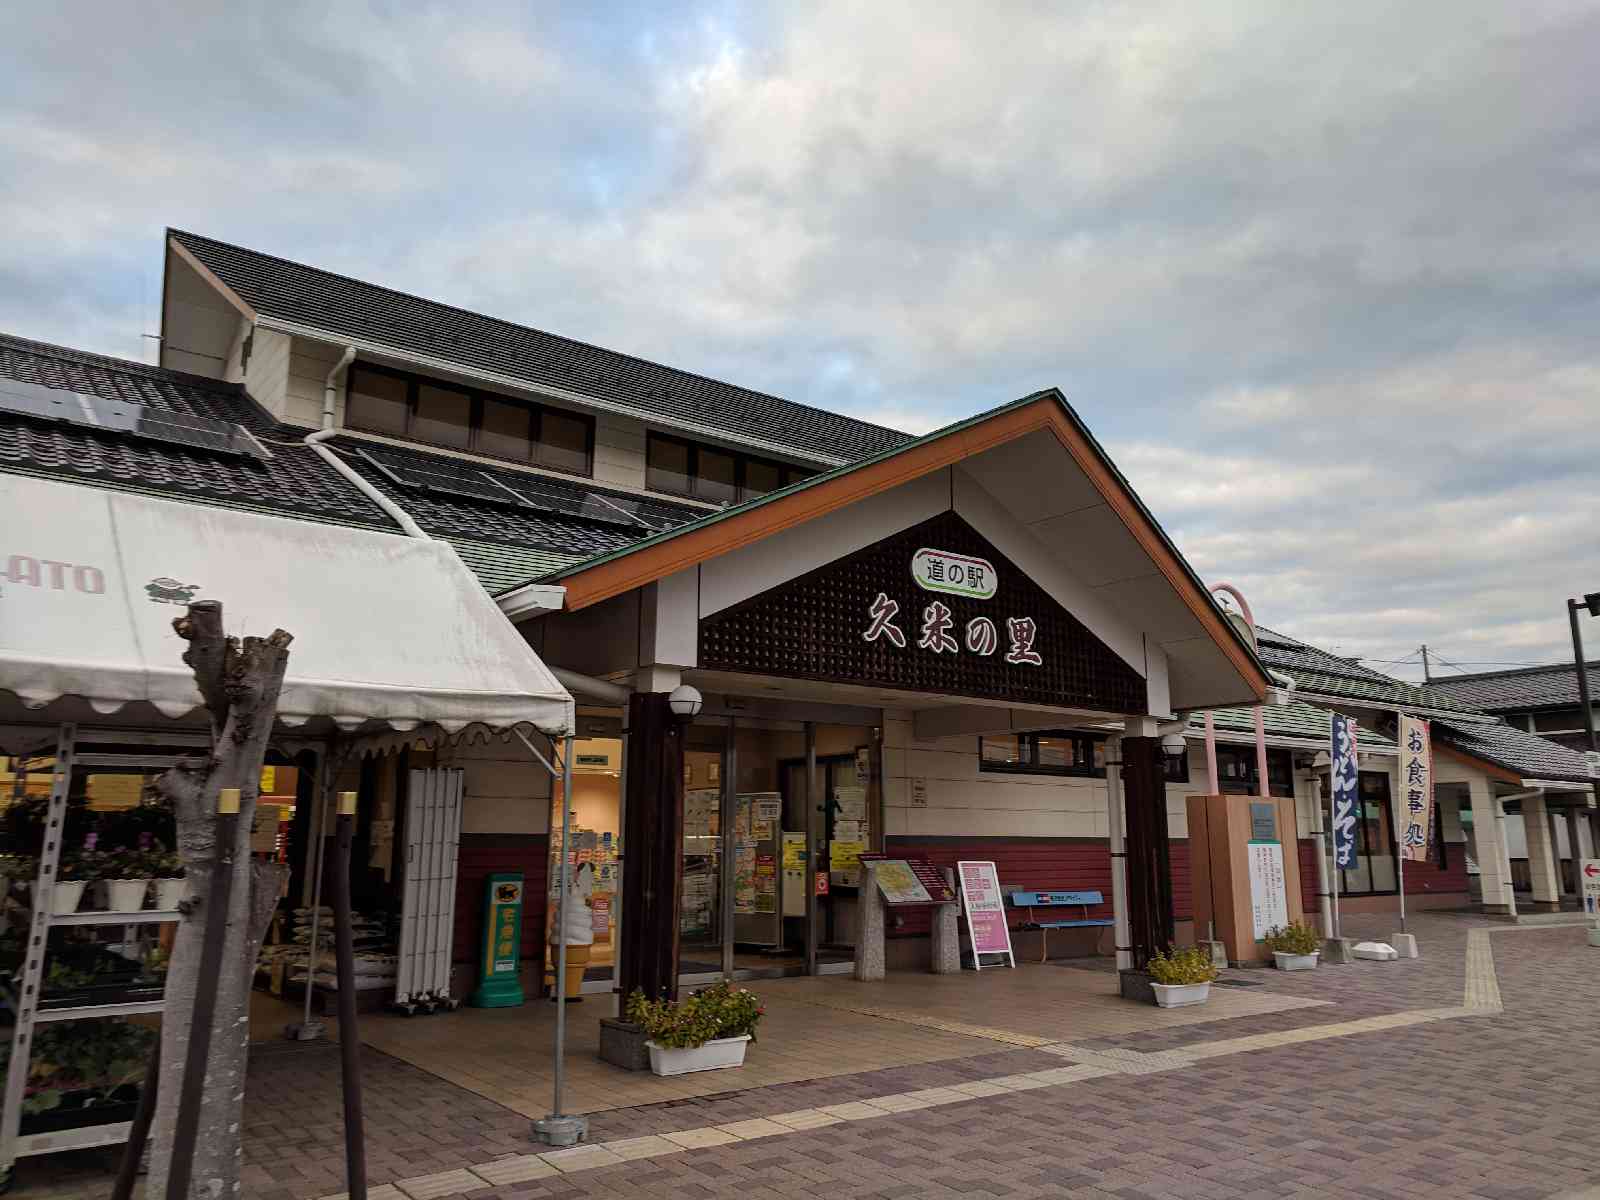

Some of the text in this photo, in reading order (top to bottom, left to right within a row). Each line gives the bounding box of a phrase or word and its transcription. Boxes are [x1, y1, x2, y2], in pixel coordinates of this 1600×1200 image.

[0, 554, 105, 594] ATO
[927, 558, 985, 589] 道の駅
[863, 592, 1043, 666] 久米の里
[1406, 727, 1428, 847] お食事処
